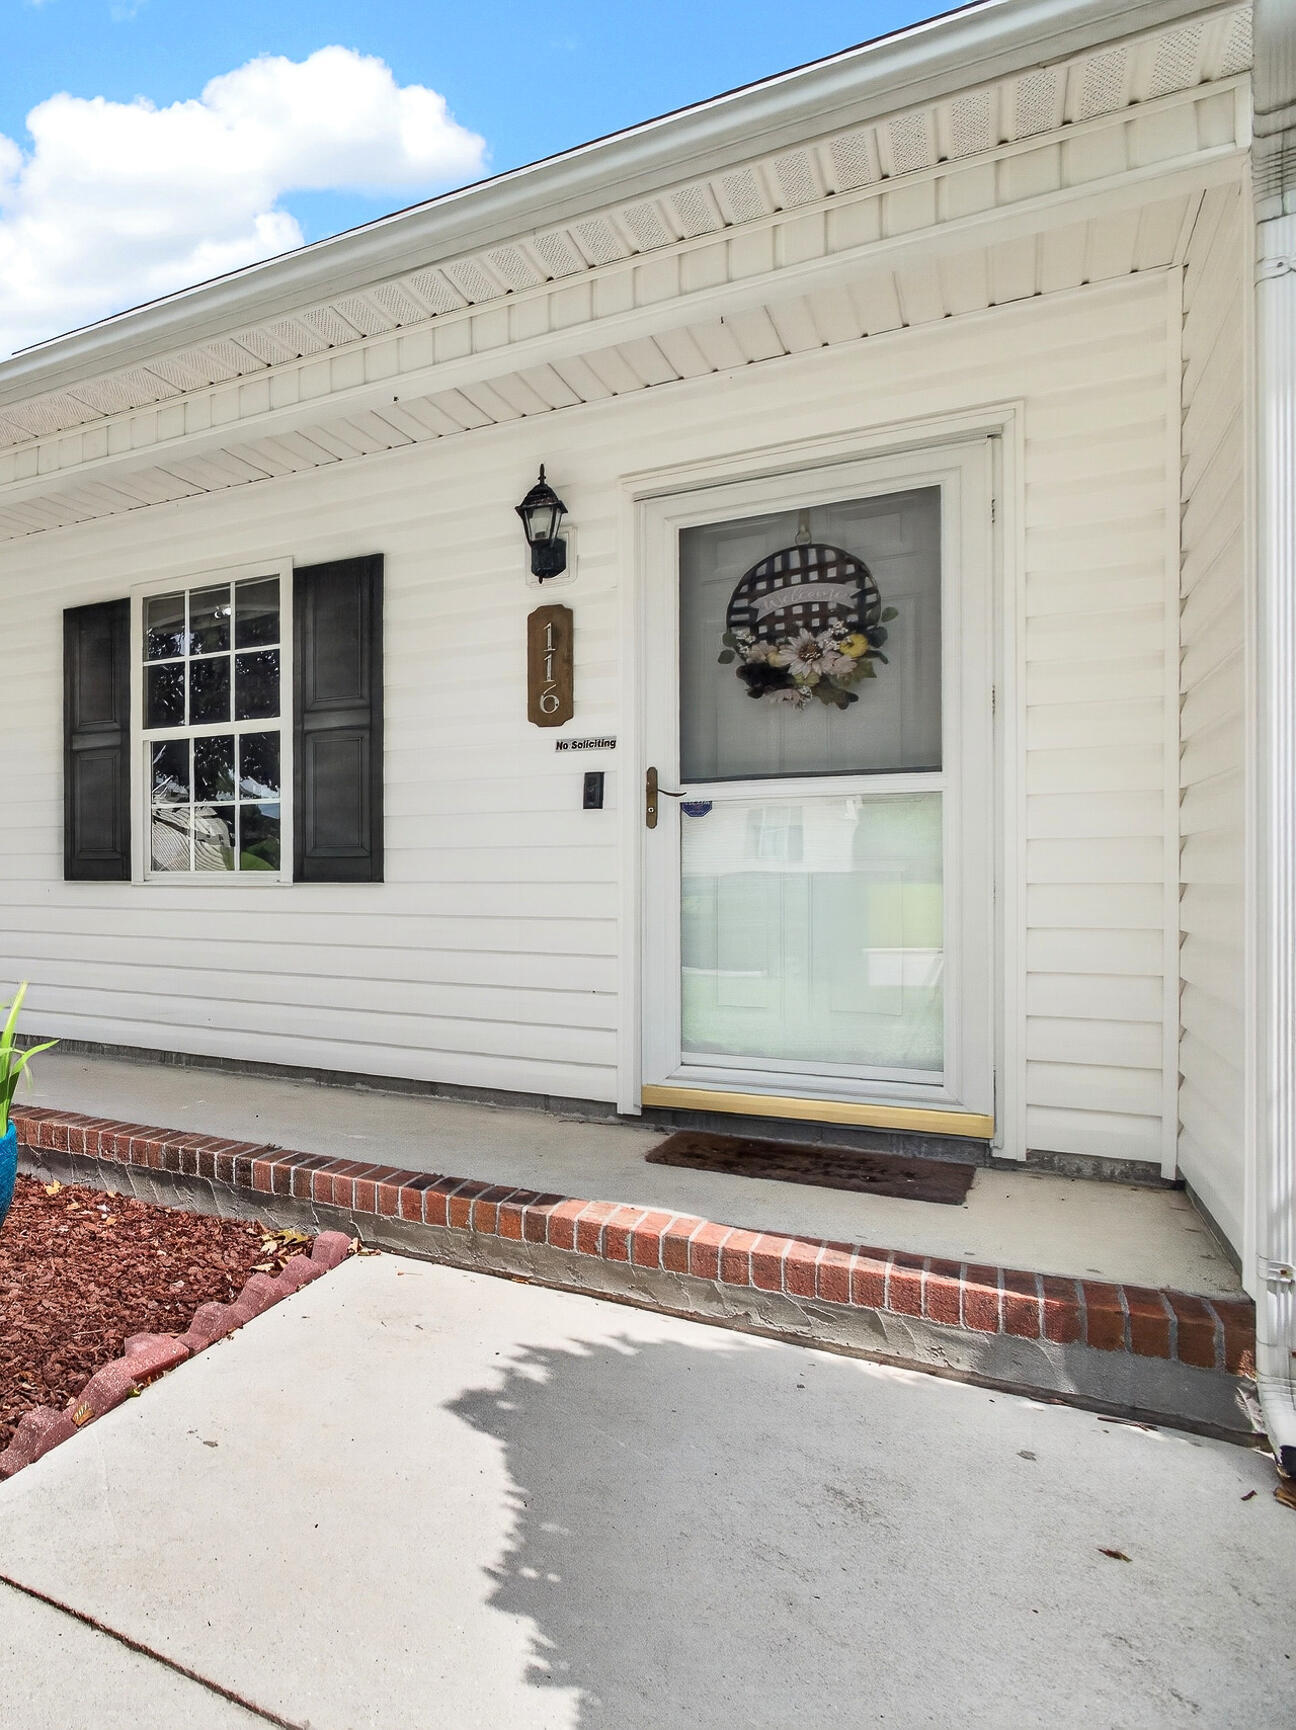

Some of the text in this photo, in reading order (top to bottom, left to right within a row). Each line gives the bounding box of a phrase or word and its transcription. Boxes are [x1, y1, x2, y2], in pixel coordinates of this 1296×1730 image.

[540, 622, 560, 714] 116
[556, 739, 616, 750] No Soliciting
